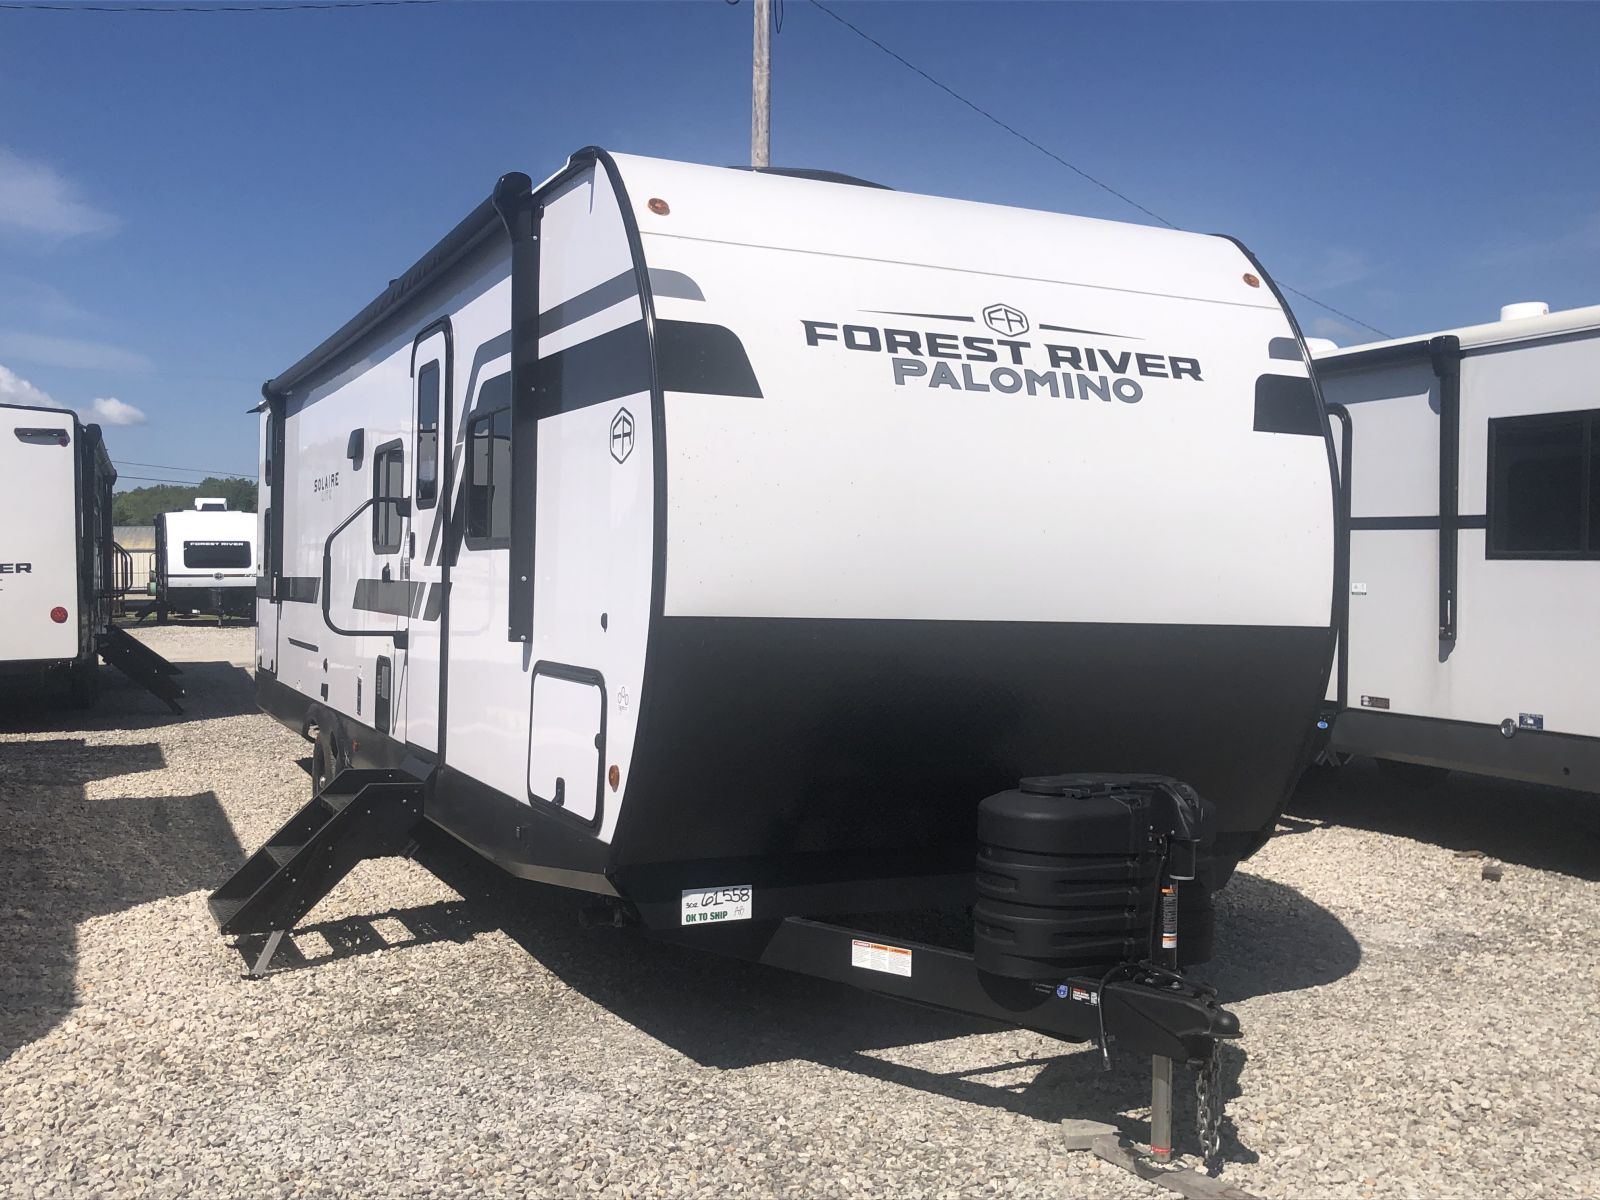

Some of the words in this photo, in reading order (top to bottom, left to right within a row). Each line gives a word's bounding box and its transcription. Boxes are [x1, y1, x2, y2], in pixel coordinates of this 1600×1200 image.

[800, 320, 1032, 365] FOREST
[1044, 344, 1204, 382] RIVER
[892, 357, 1144, 404] PALOMINO
[314, 472, 339, 492] SOLAIRE
[701, 888, 750, 907] 61558
[686, 914, 697, 922] OK
[698, 913, 708, 921] TO
[710, 911, 728, 920] SHIP
